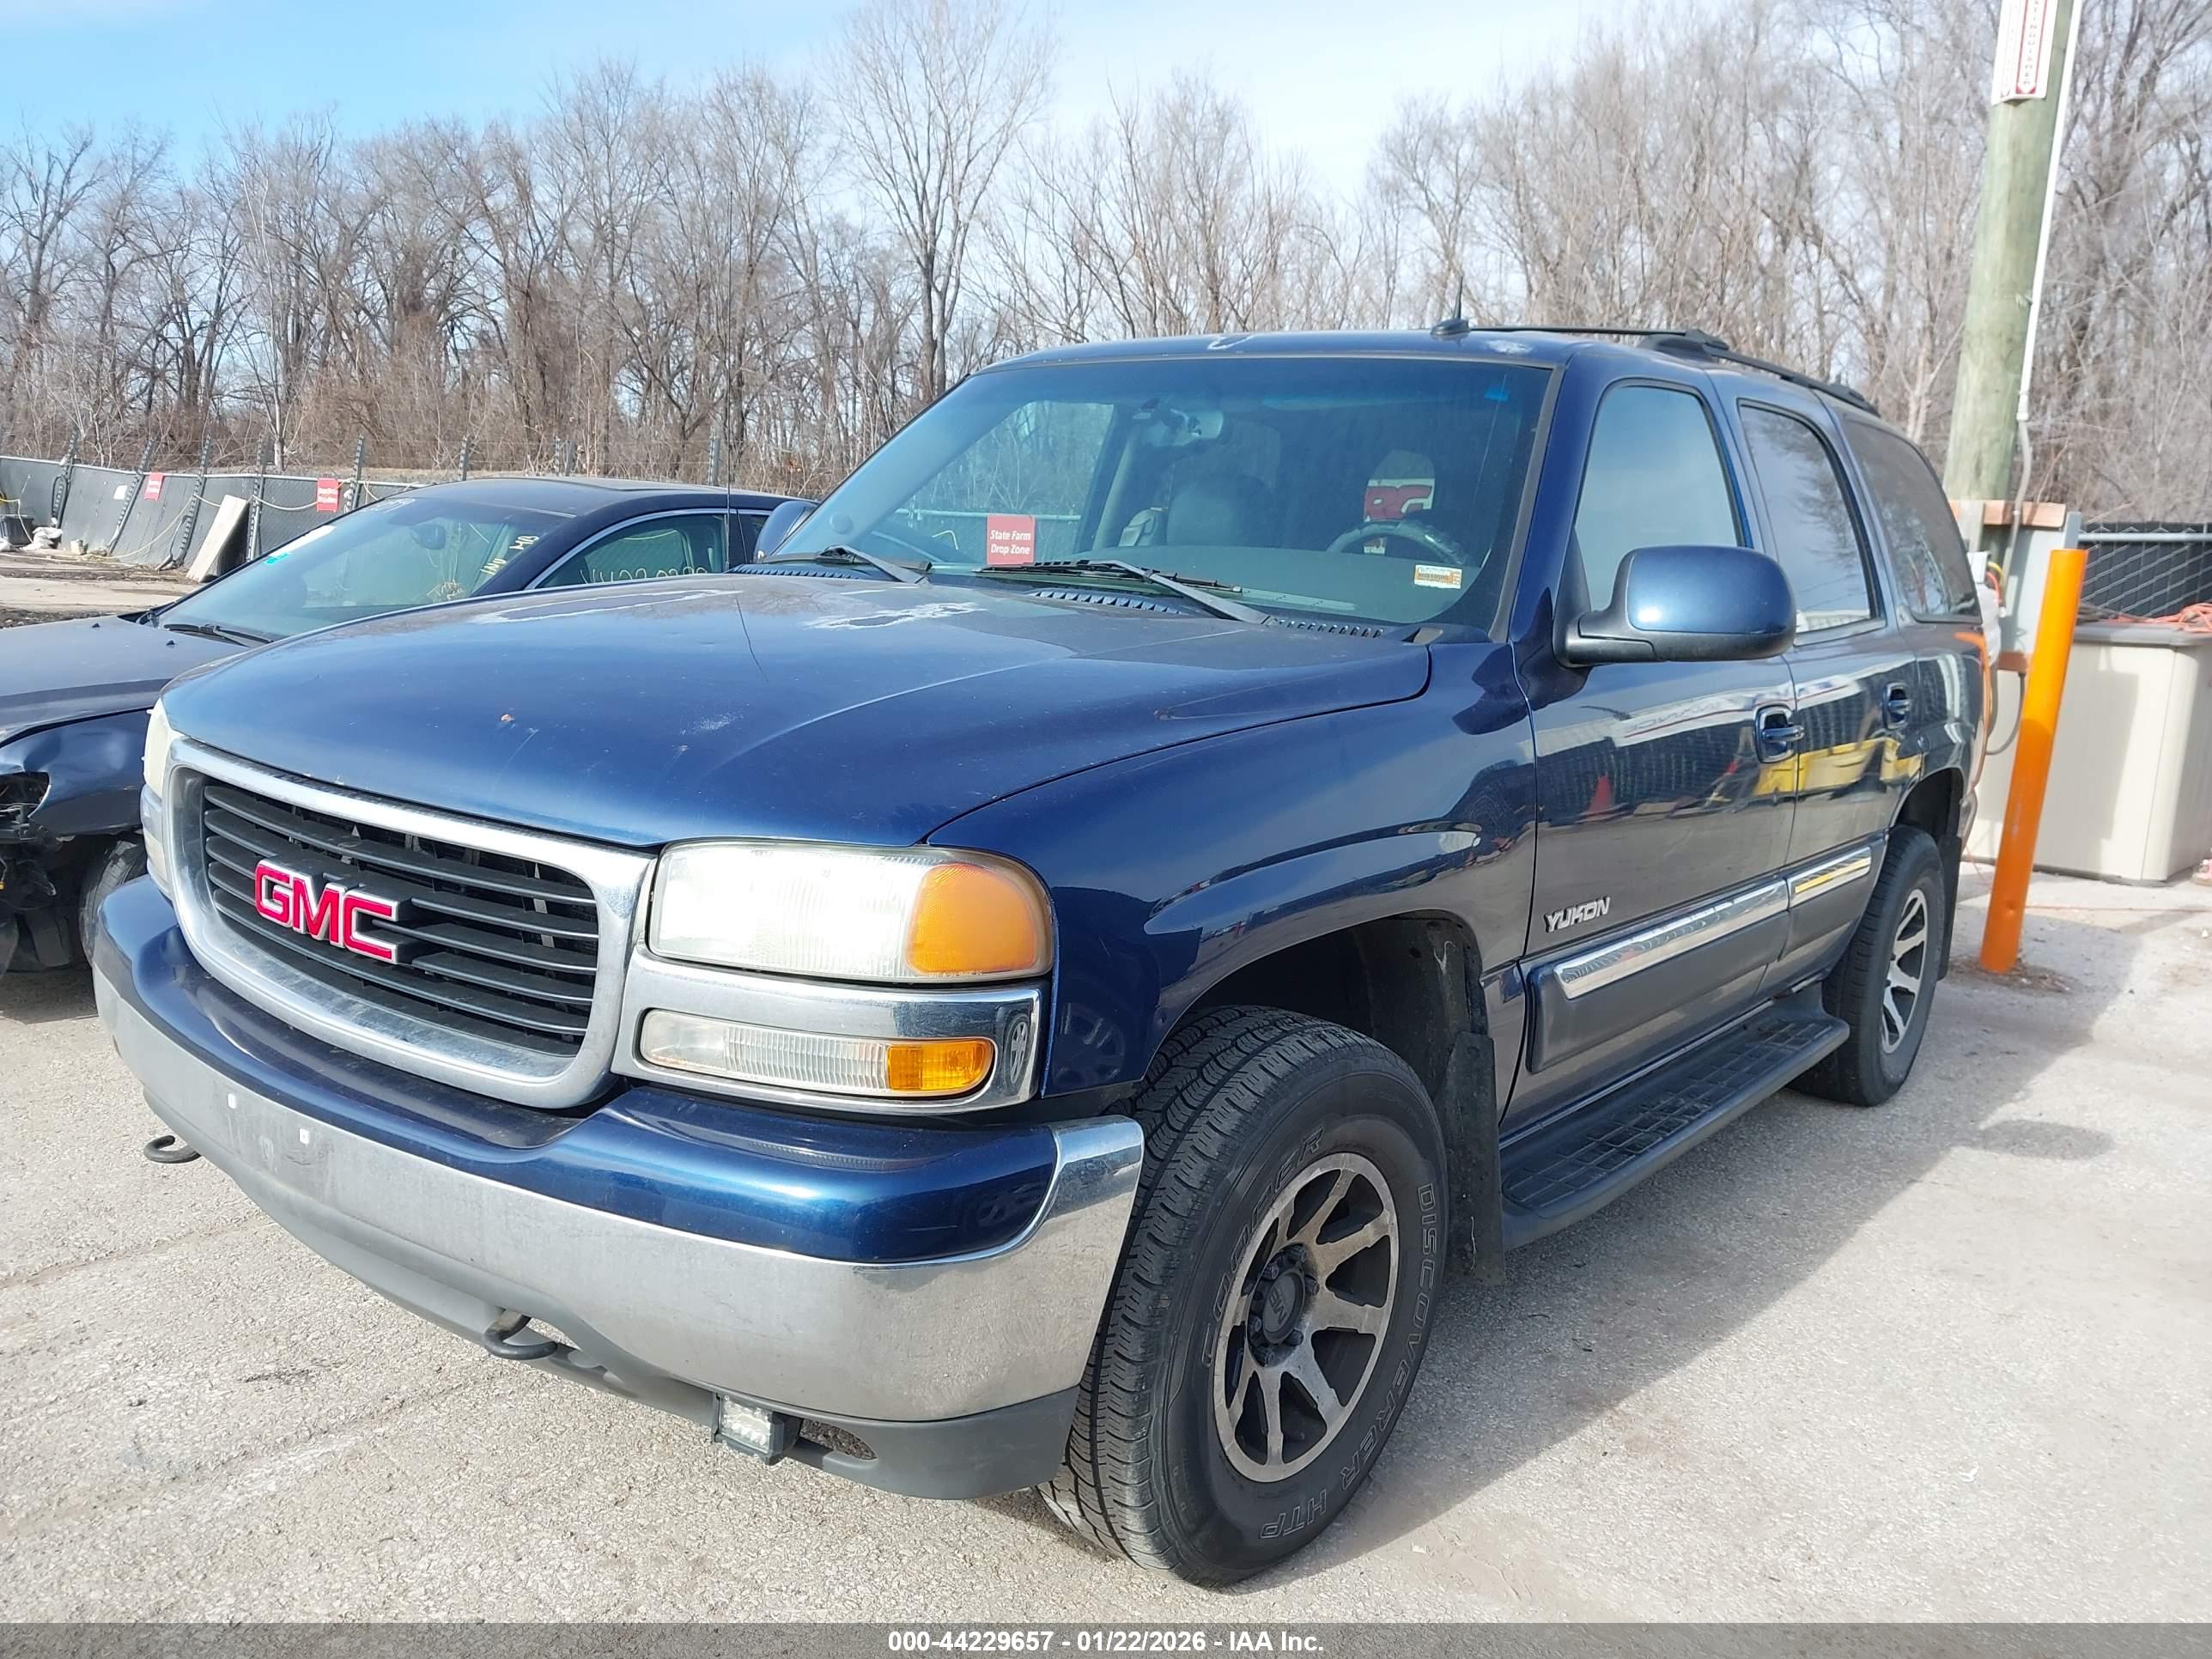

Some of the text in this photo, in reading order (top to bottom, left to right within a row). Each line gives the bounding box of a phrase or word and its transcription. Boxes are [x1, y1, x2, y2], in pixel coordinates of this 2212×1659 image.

[990, 530, 1031, 541] State Farm
[990, 544, 1030, 556] Drop Zone
[255, 859, 398, 964] GMC
[1544, 896, 1611, 933] YUKON
[1340, 1182, 1437, 1492] DISCOVERER
[1259, 1488, 1328, 1539] HTP
